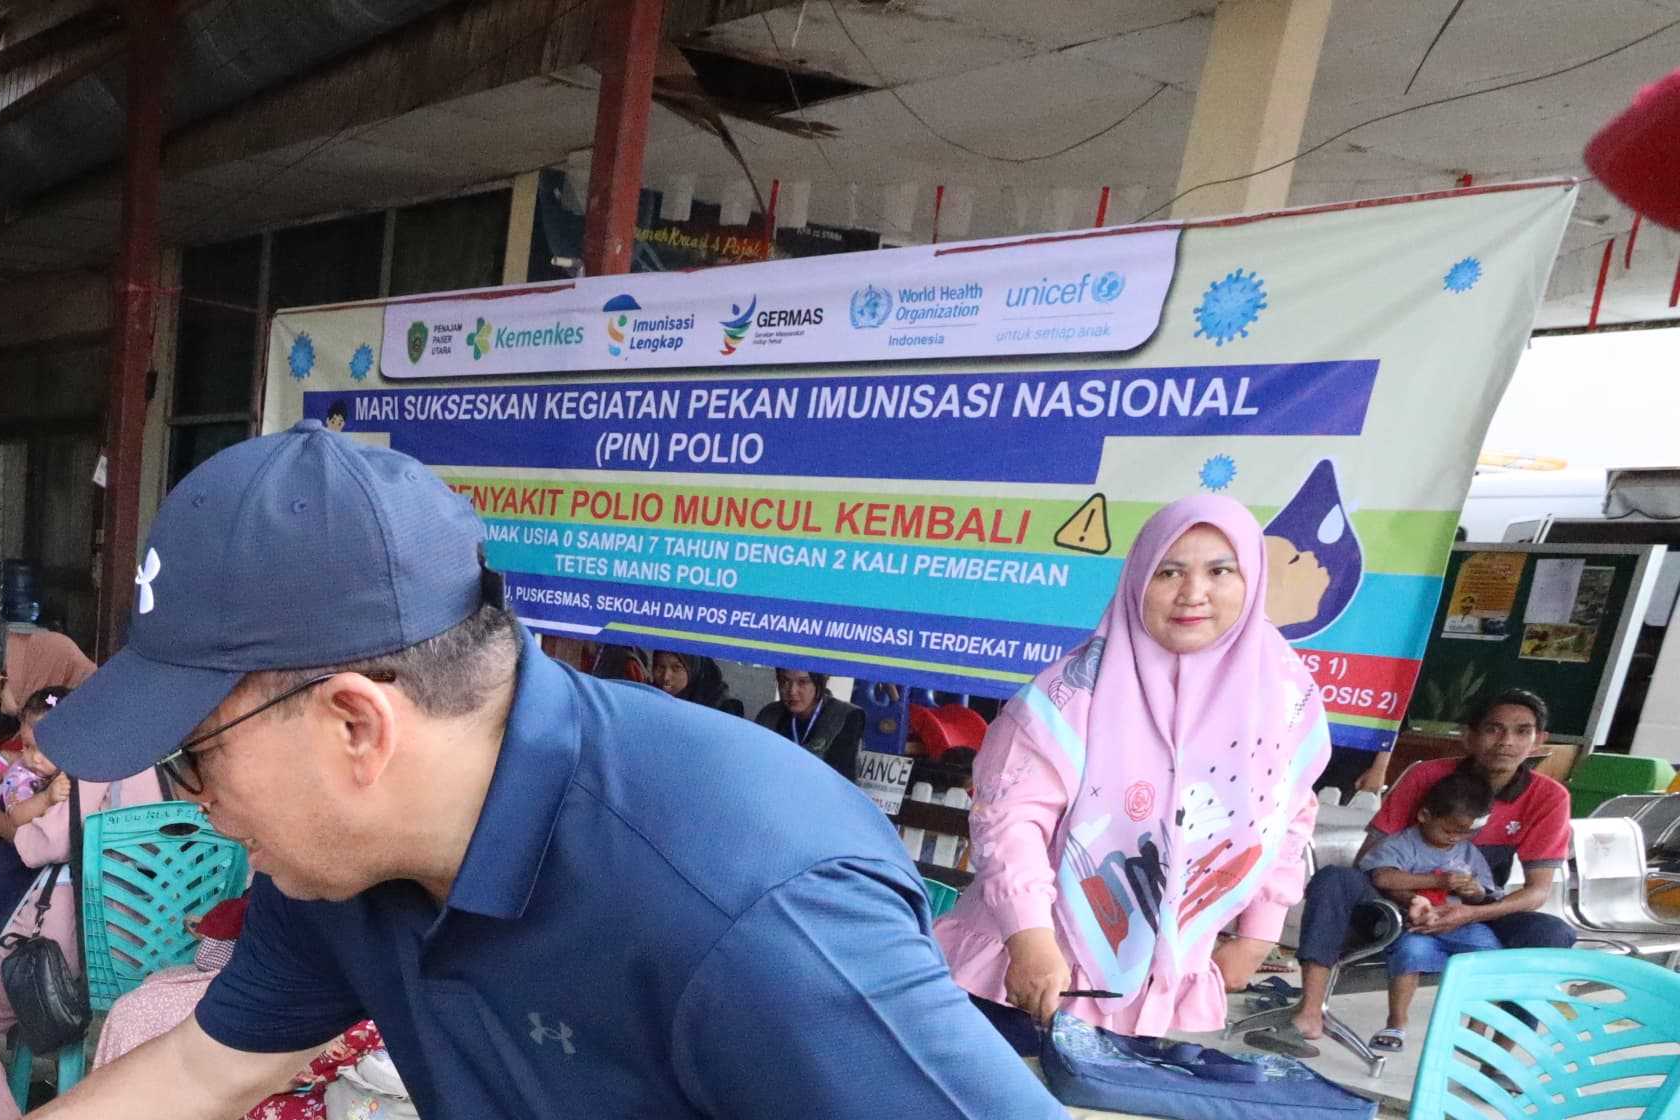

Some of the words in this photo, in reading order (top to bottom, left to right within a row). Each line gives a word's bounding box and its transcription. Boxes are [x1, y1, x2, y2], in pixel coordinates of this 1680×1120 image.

[898, 287, 936, 304] World
[939, 282, 984, 301] Health
[1006, 273, 1091, 308] unicef
[632, 313, 695, 333] Imunisasi
[756, 308, 823, 328] GERMAS
[895, 304, 980, 322] Organization
[433, 323, 463, 333] PENAJAM
[495, 323, 585, 349] Kemenkes
[1078, 324, 1112, 339] anak
[629, 336, 684, 353] Lengkap
[888, 334, 945, 347] Indonesia
[355, 396, 399, 421] MARI
[403, 393, 537, 421] SUKSESKAN
[543, 390, 680, 420] KEGIATAN
[687, 387, 799, 419] PEKAN
[807, 382, 1005, 419] IMUNISASI
[1012, 377, 1260, 418] NASIONAL
[595, 432, 658, 468] (PIN)
[667, 432, 765, 465] POLIO
[570, 490, 664, 523] POLIO
[673, 494, 822, 533] MUNCUL
[834, 501, 1032, 545] KEMBALI
[523, 527, 559, 547] USIA
[563, 531, 573, 548] 0
[576, 531, 643, 553] SAMPAI
[649, 536, 658, 554] 7
[663, 537, 729, 562] TAHUN
[733, 540, 827, 569] DENGAN
[831, 549, 846, 571] 2
[851, 550, 907, 576] KALI
[913, 555, 1070, 588] PEMBERIAN
[555, 554, 607, 577] TETES
[612, 560, 671, 582] MANIS
[677, 566, 738, 590] POLIO
[516, 586, 593, 611] PUSKESMAS,
[596, 594, 661, 617] SEKOLAH
[665, 603, 694, 621] DAN
[698, 606, 727, 625] POS
[729, 610, 822, 637] PELAYANAN
[824, 621, 914, 647] IMUNISASI
[917, 630, 1019, 660] TERDEKAT
[1328, 656, 1348, 680] 1)
[1377, 691, 1398, 714] 2)
